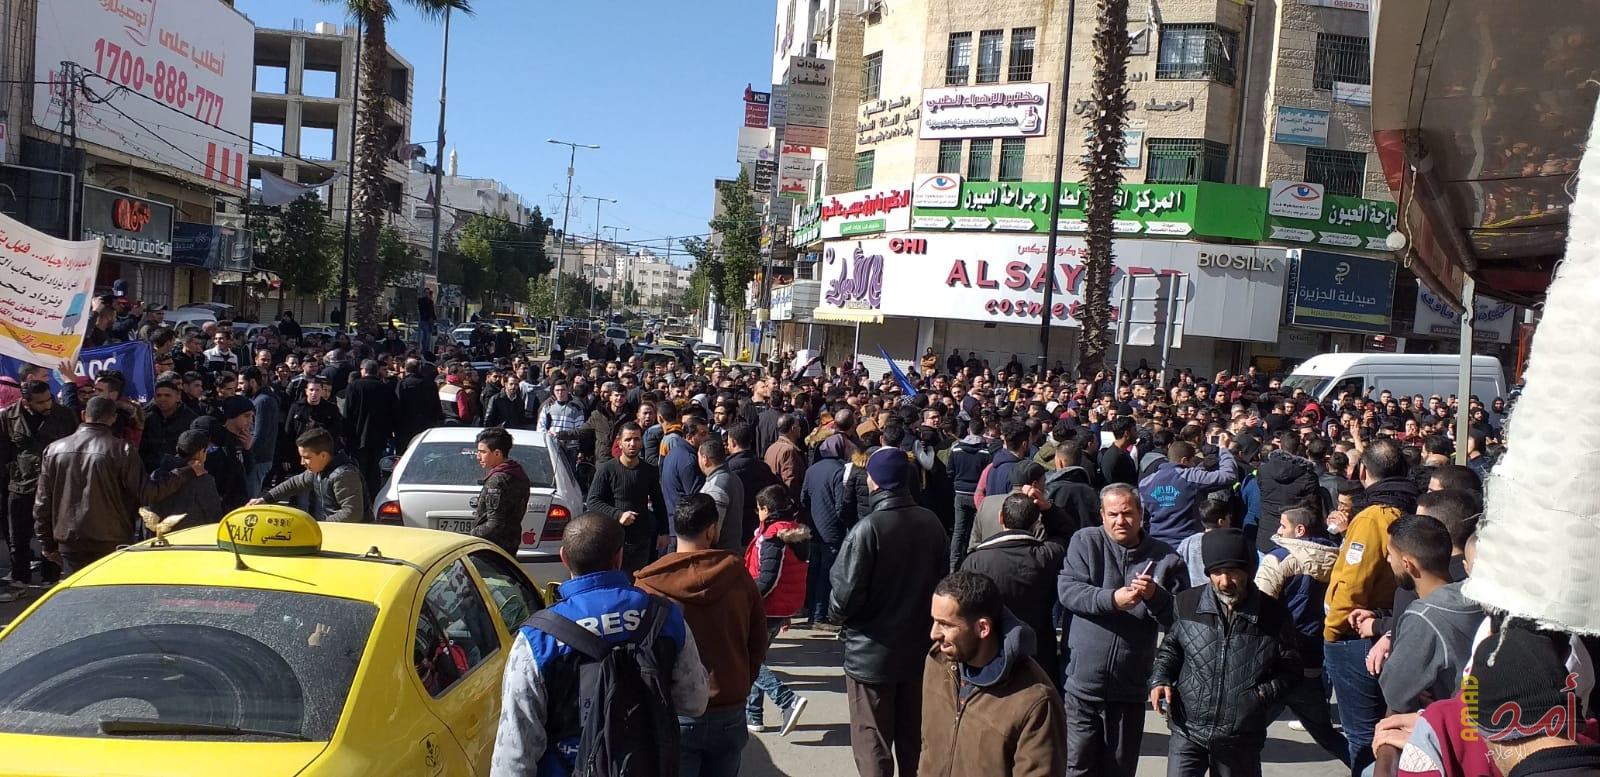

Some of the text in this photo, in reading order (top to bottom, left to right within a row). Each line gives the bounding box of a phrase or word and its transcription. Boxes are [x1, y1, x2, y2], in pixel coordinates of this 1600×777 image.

[159, 27, 189, 56] على
[94, 37, 224, 128] 1700-888-777
[963, 187, 999, 210] العيون
[1000, 183, 1037, 211] جراحة
[1132, 188, 1183, 214] المركز
[1328, 204, 1368, 226] العيون
[888, 237, 927, 255] CHI
[1197, 251, 1276, 272] BIOSILK
[10, 264, 49, 282] أصحاب
[1299, 285, 1376, 307] صيدلية الجزيرة
[229, 524, 254, 542] TAXI
[443, 520, 472, 532] 7-709
[261, 531, 292, 544] تكسي
